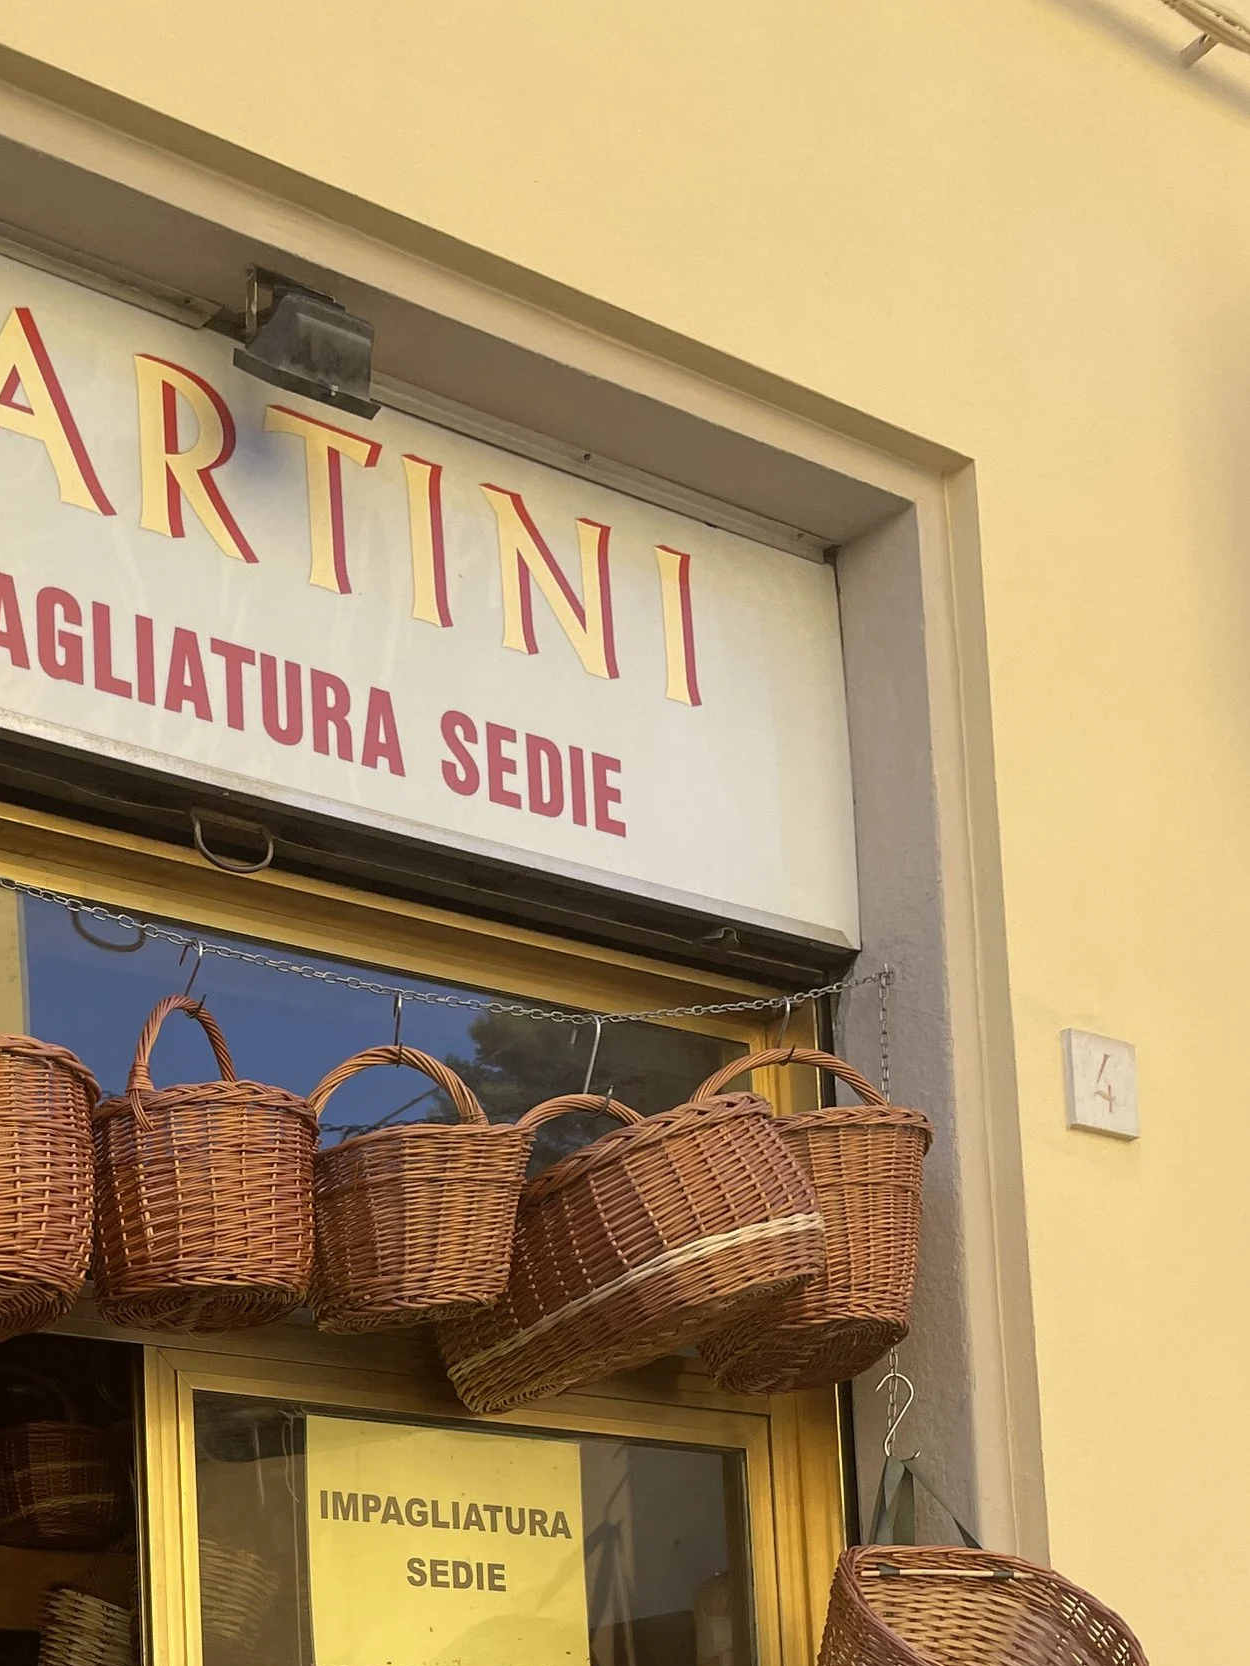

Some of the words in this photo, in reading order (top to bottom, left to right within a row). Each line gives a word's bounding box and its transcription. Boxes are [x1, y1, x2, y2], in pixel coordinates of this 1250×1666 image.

[440, 709, 628, 838] SEDIE
[1092, 1053, 1118, 1113] 4
[319, 1489, 573, 1540] IMPAGLIATURA
[406, 1557, 507, 1593] SEDIE
